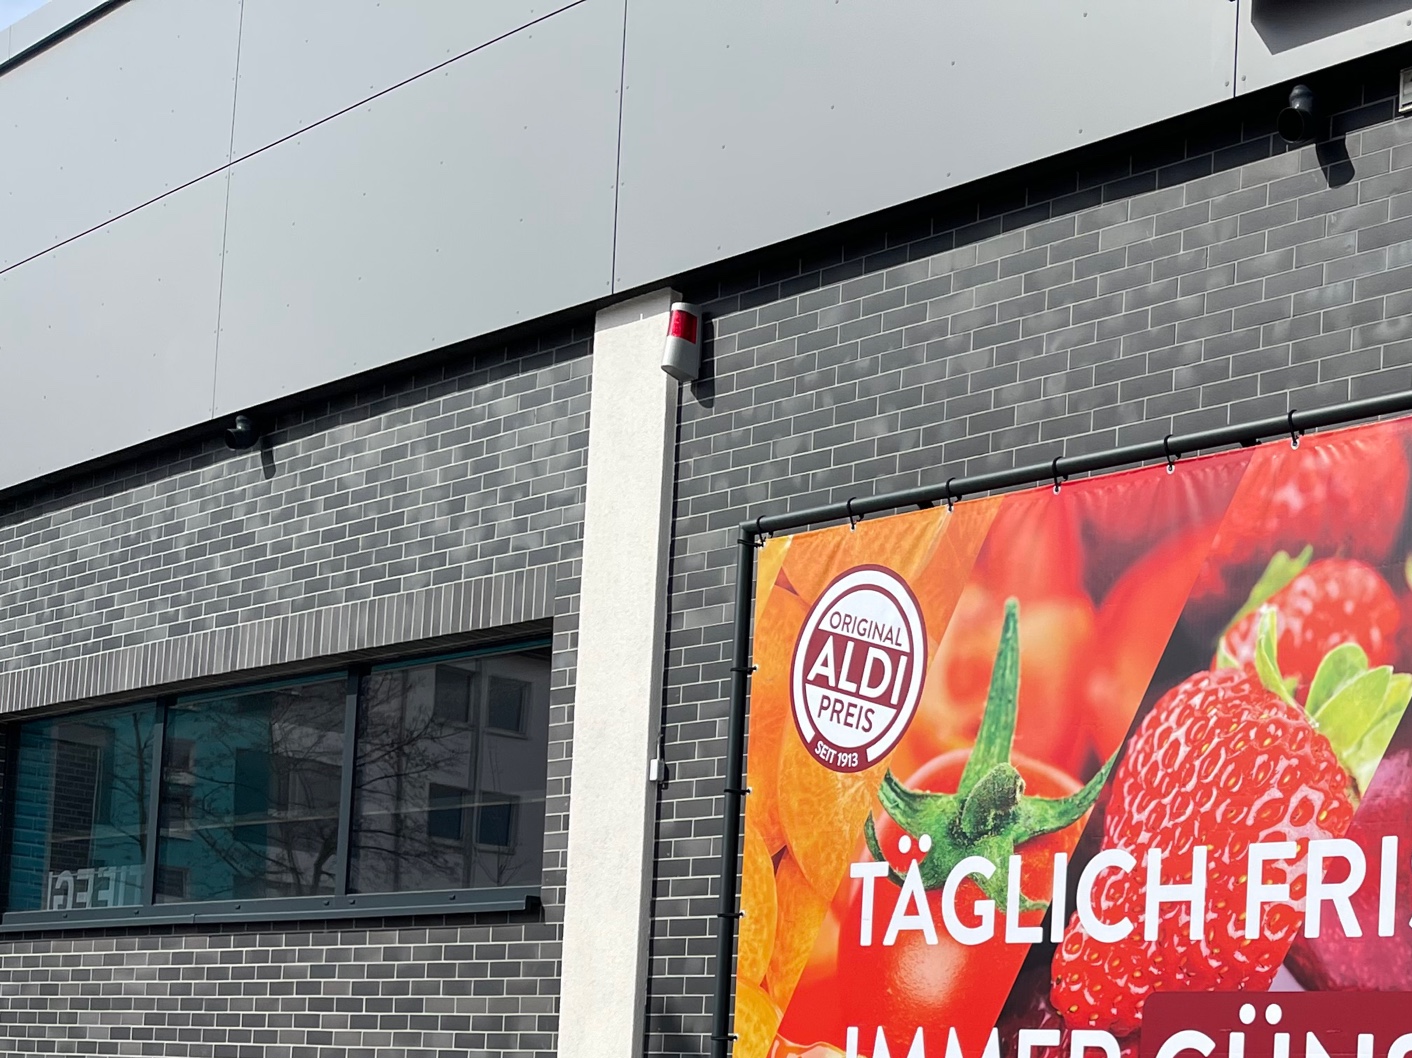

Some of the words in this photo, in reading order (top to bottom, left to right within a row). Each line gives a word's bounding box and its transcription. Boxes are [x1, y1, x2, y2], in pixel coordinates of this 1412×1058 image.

[829, 610, 903, 647] ORIGINAL
[806, 635, 908, 706] ALDI
[817, 694, 876, 733] PREIS
[814, 740, 837, 765] SEIT
[836, 752, 859, 768] 1913
[849, 834, 1207, 947] TÄGLICH
